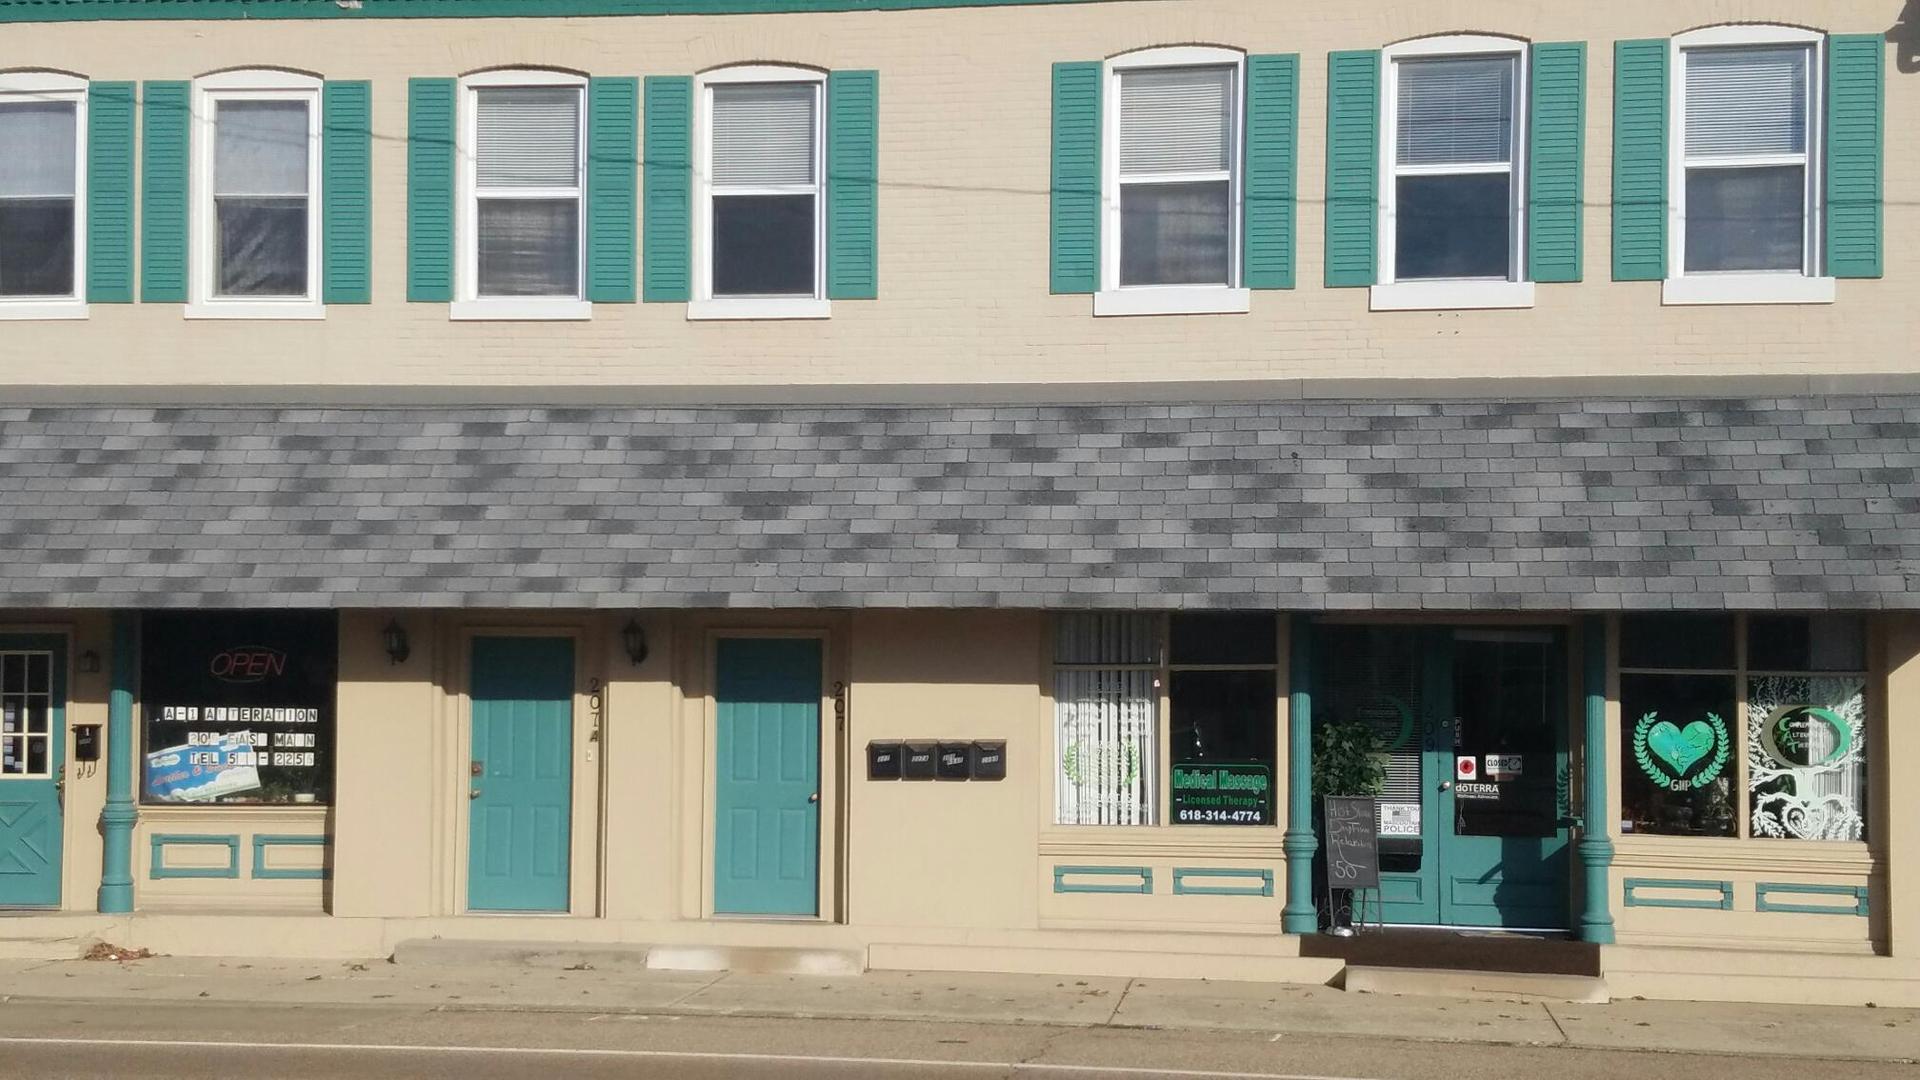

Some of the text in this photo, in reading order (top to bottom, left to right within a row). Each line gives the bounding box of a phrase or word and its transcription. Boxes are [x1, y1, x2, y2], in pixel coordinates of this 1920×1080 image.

[211, 653, 287, 676] OPEN
[165, 707, 198, 720] A-1
[228, 732, 268, 746] EAS
[275, 733, 314, 746] MAN
[190, 752, 219, 764] TEL
[1174, 769, 1267, 794] Medical Massage
[1182, 795, 1258, 807] Licensed Therapy
[1180, 809, 1260, 821] 618-314-4774
